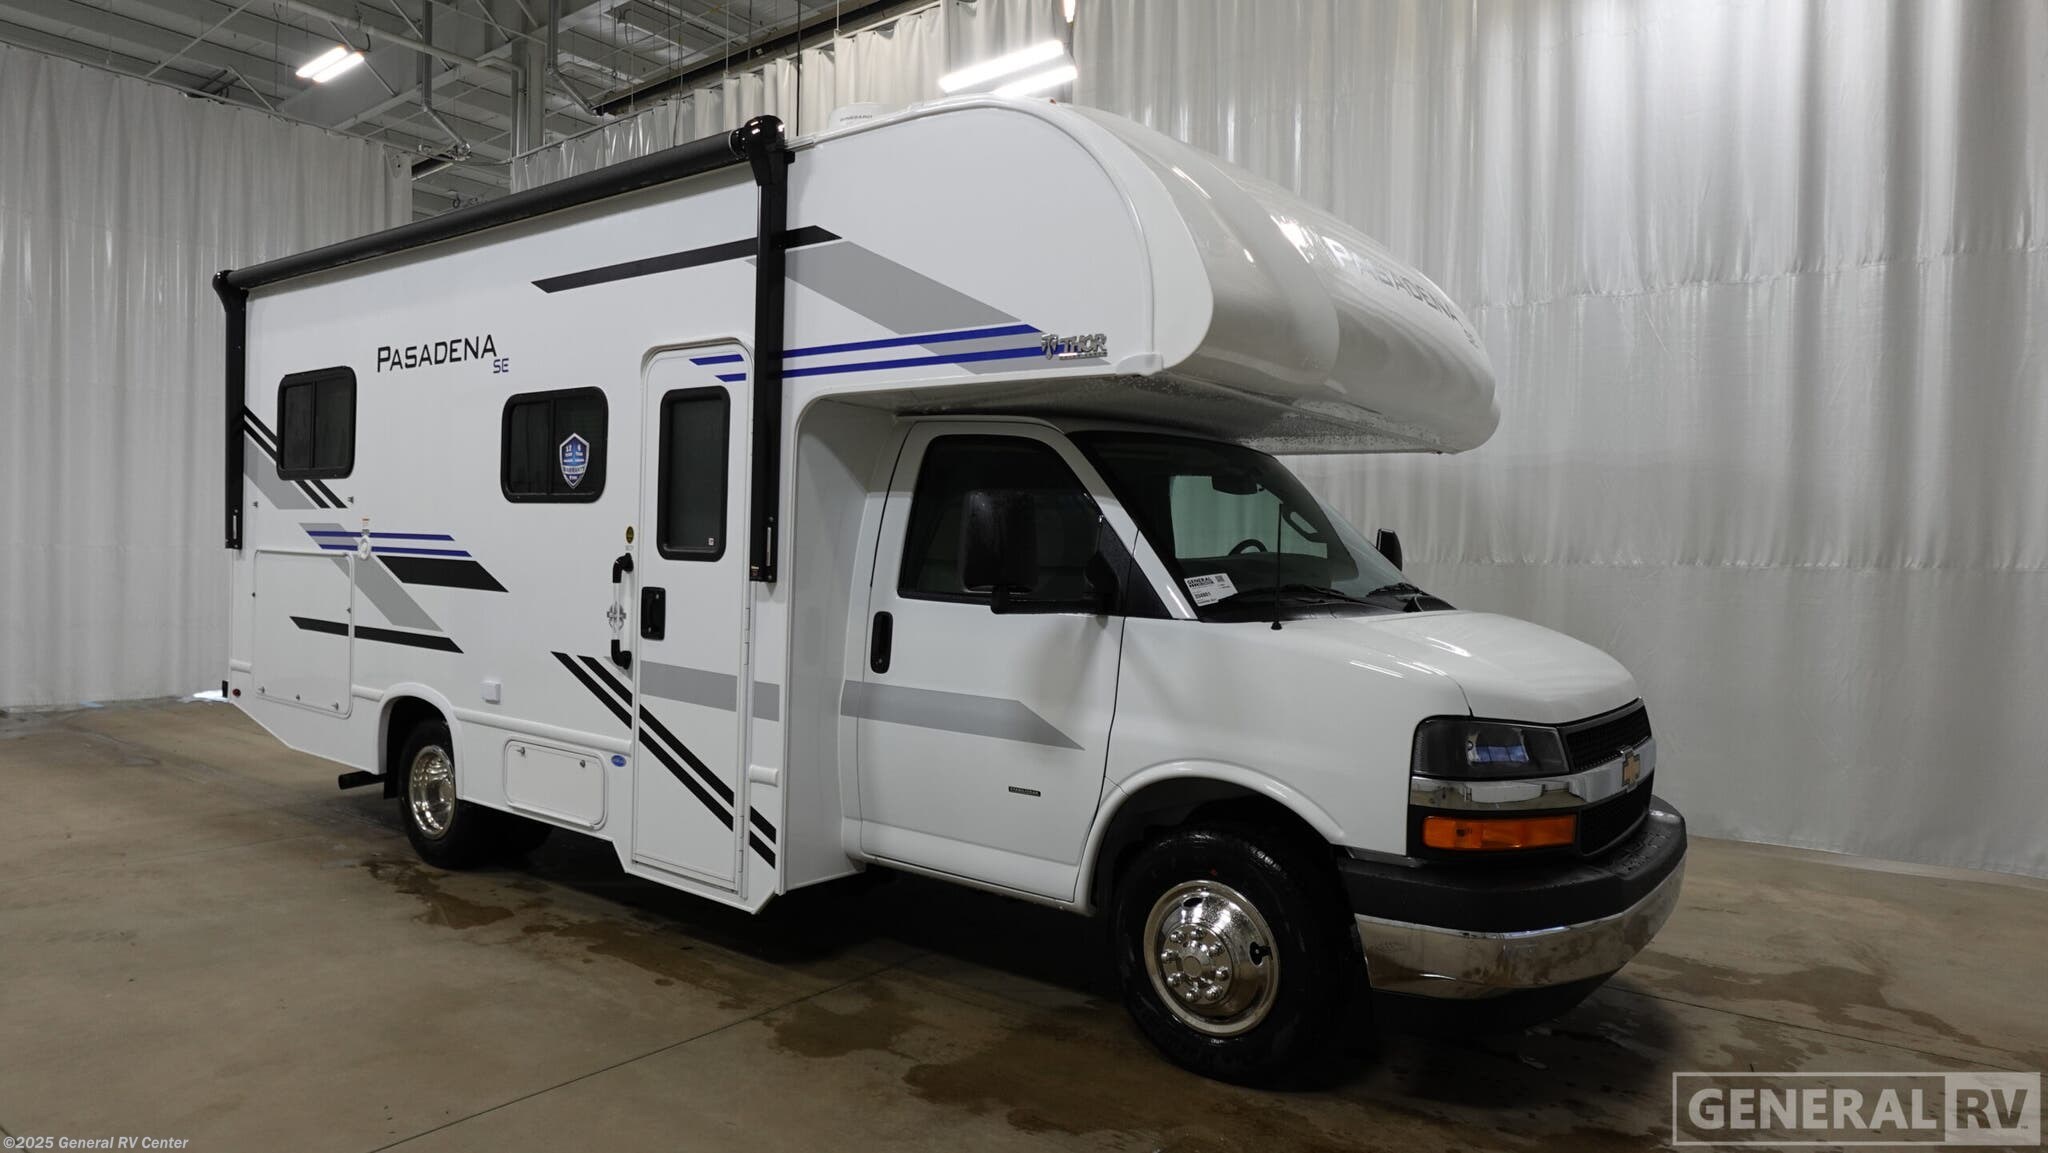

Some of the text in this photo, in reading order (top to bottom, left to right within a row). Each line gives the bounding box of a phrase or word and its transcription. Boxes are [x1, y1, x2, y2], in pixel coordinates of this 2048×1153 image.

[1060, 333, 1108, 353] THOR
[377, 334, 497, 373] PASADENA
[493, 358, 510, 374] SE
